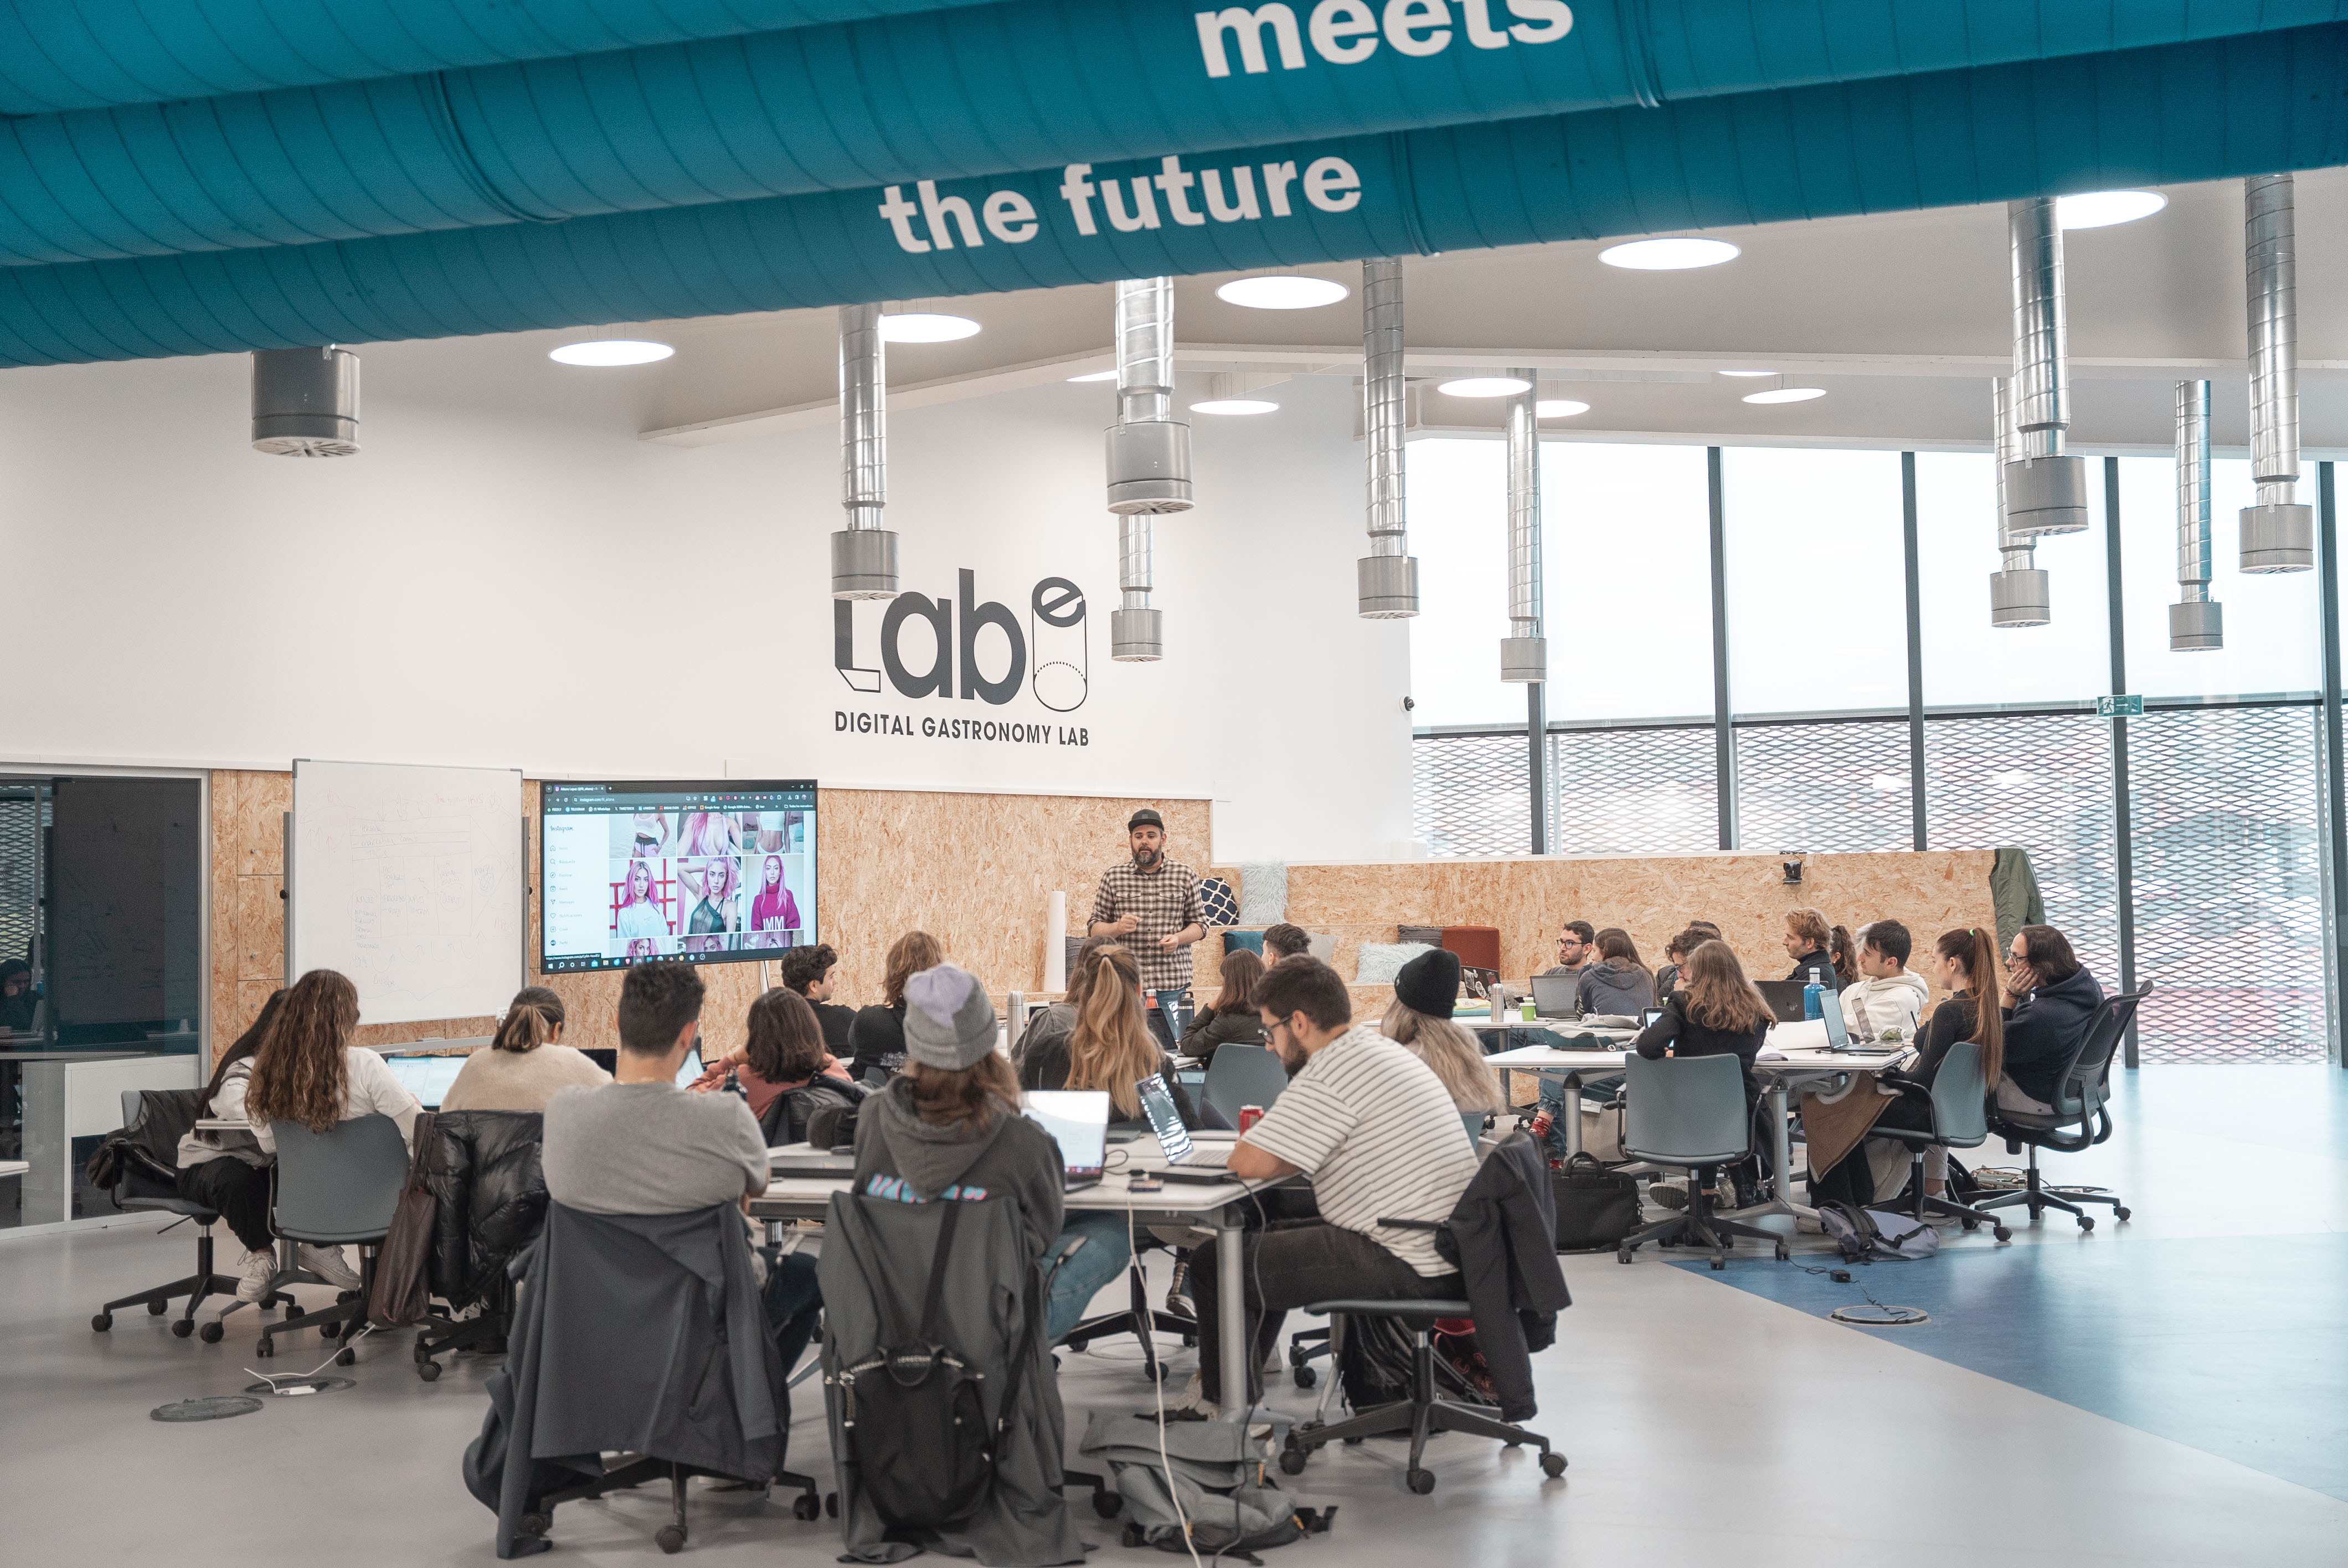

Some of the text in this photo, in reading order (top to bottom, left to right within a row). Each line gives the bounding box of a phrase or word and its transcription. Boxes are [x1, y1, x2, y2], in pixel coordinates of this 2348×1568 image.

[1195, 0, 1573, 78] meets
[878, 155, 1362, 254] the future
[835, 711, 1089, 746] DIGITAL GASTRONOMY LAB
[550, 825, 574, 833] Instagram
